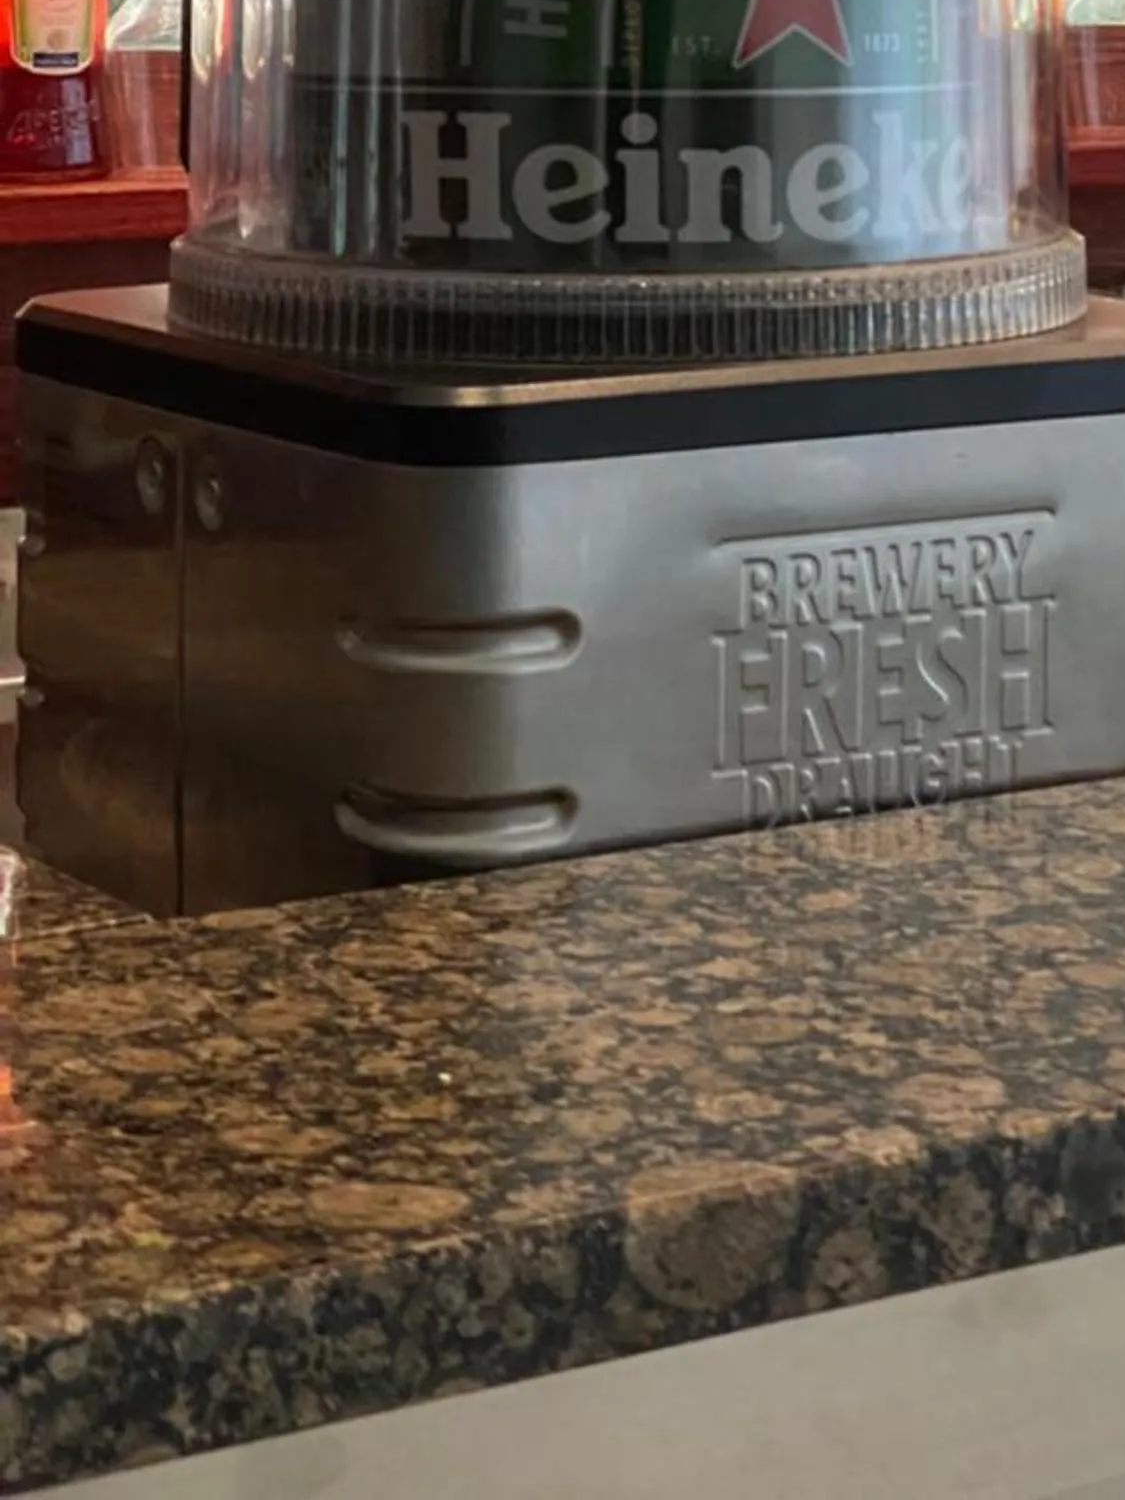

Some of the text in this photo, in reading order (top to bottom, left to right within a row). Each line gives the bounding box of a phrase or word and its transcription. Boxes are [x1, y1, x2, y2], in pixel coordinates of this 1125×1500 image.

[863, 32, 900, 54] 1873
[740, 529, 1036, 631] BREWERY
[708, 593, 1058, 779] FRESH
